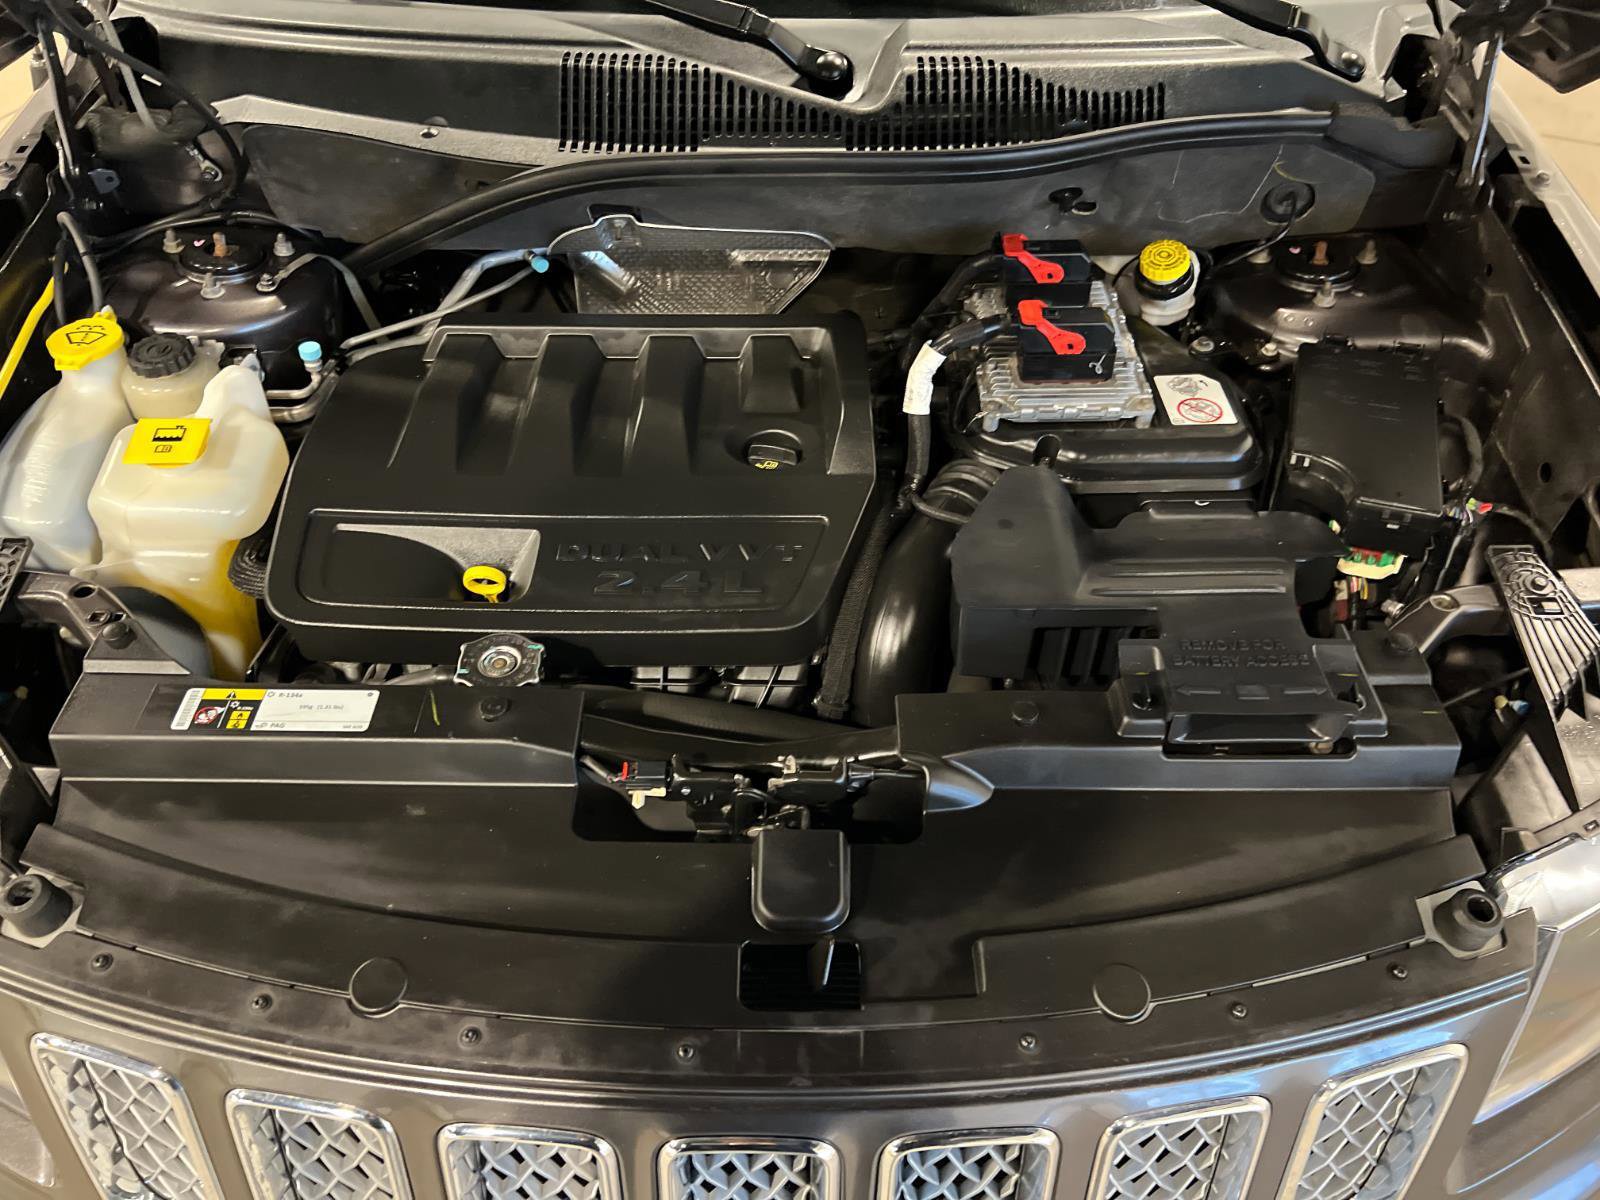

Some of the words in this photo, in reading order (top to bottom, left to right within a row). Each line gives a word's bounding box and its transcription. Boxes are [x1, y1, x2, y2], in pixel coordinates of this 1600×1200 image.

[556, 543, 688, 562] DUAL
[699, 543, 803, 562] VVT
[593, 570, 764, 596] 2.4L
[1180, 639, 1249, 651] REMOVE
[1251, 639, 1287, 651] FOR
[1173, 654, 1240, 667] BATTERY
[1246, 653, 1310, 667] ACCESS
